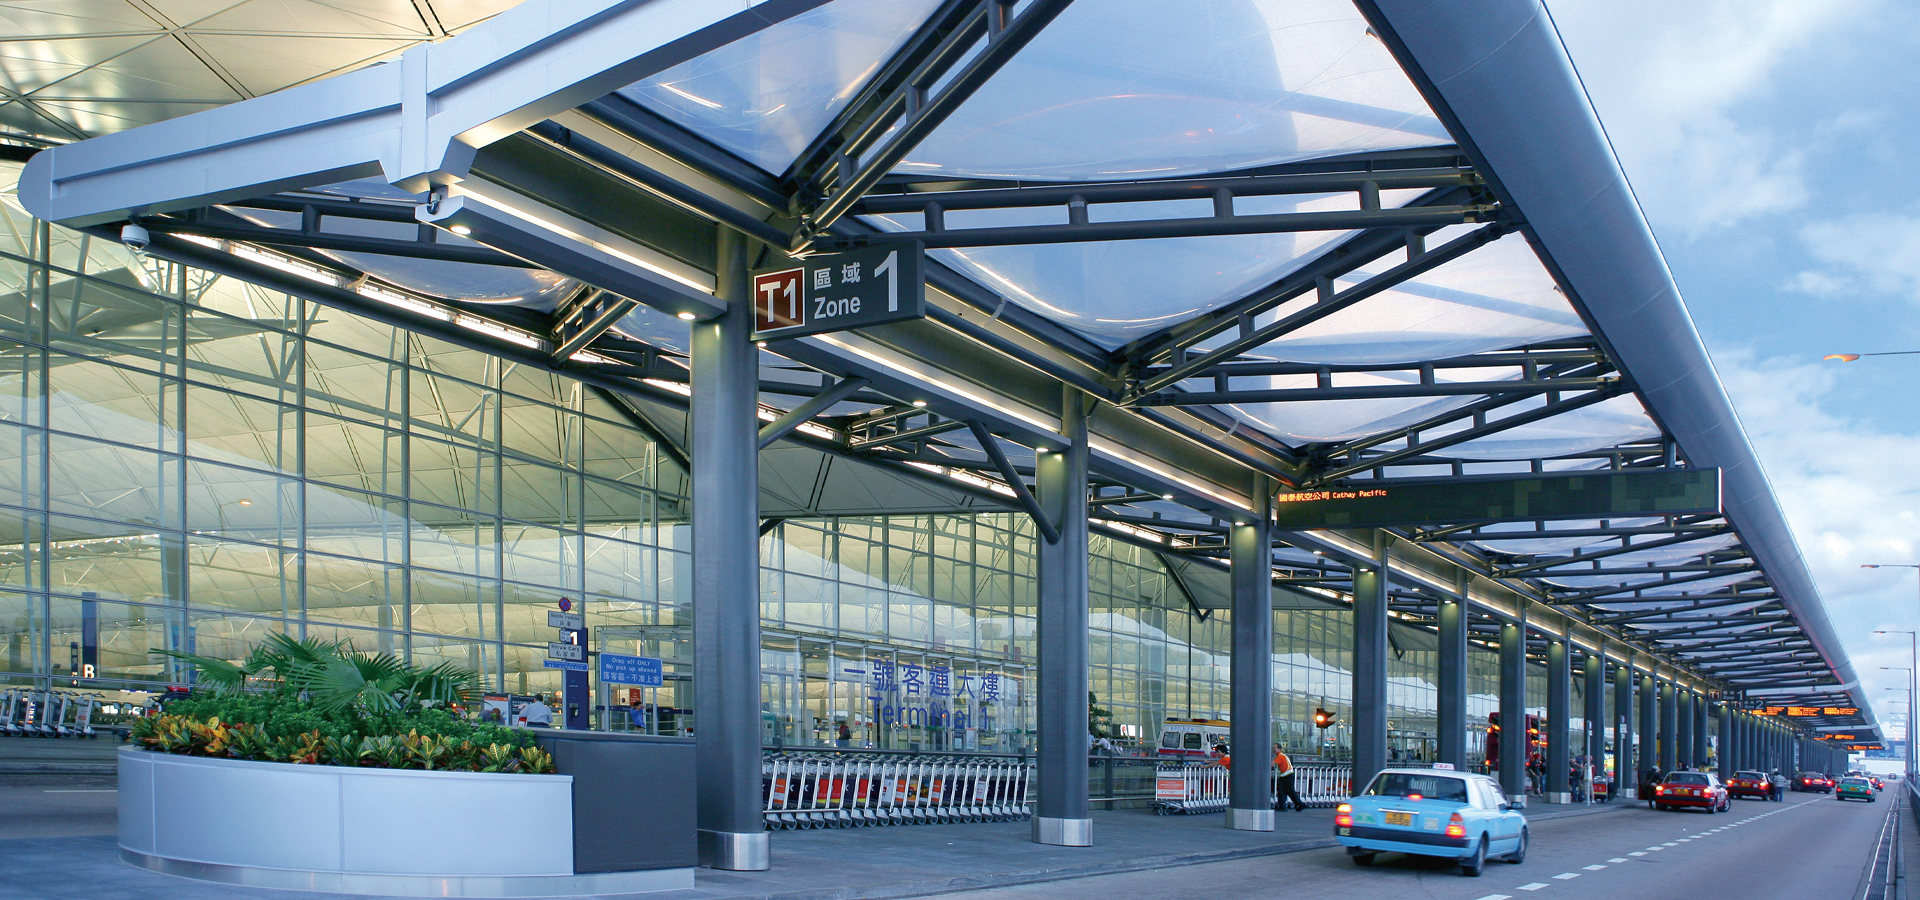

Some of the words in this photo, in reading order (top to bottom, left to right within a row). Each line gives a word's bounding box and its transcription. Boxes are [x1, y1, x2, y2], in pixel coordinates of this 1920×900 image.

[813, 261, 861, 291] 區域
[874, 250, 898, 312] 1
[760, 278, 796, 323] T1
[814, 296, 861, 320] Zone
[1278, 491, 1330, 502] 國泰航空公司
[1332, 491, 1357, 500] Cathay
[1359, 489, 1387, 498] Pacific
[570, 631, 578, 645] 1
[612, 657, 625, 665] Drop
[637, 659, 651, 667] ONLY
[615, 664, 627, 672] pick
[637, 665, 657, 673] allowed
[83, 663, 95, 679] B
[843, 658, 1000, 702] 一號客運大樓
[1737, 690, 1743, 701] 1
[867, 696, 972, 730] Terminal
[981, 706, 988, 730] 1
[1755, 700, 1764, 710] 2
